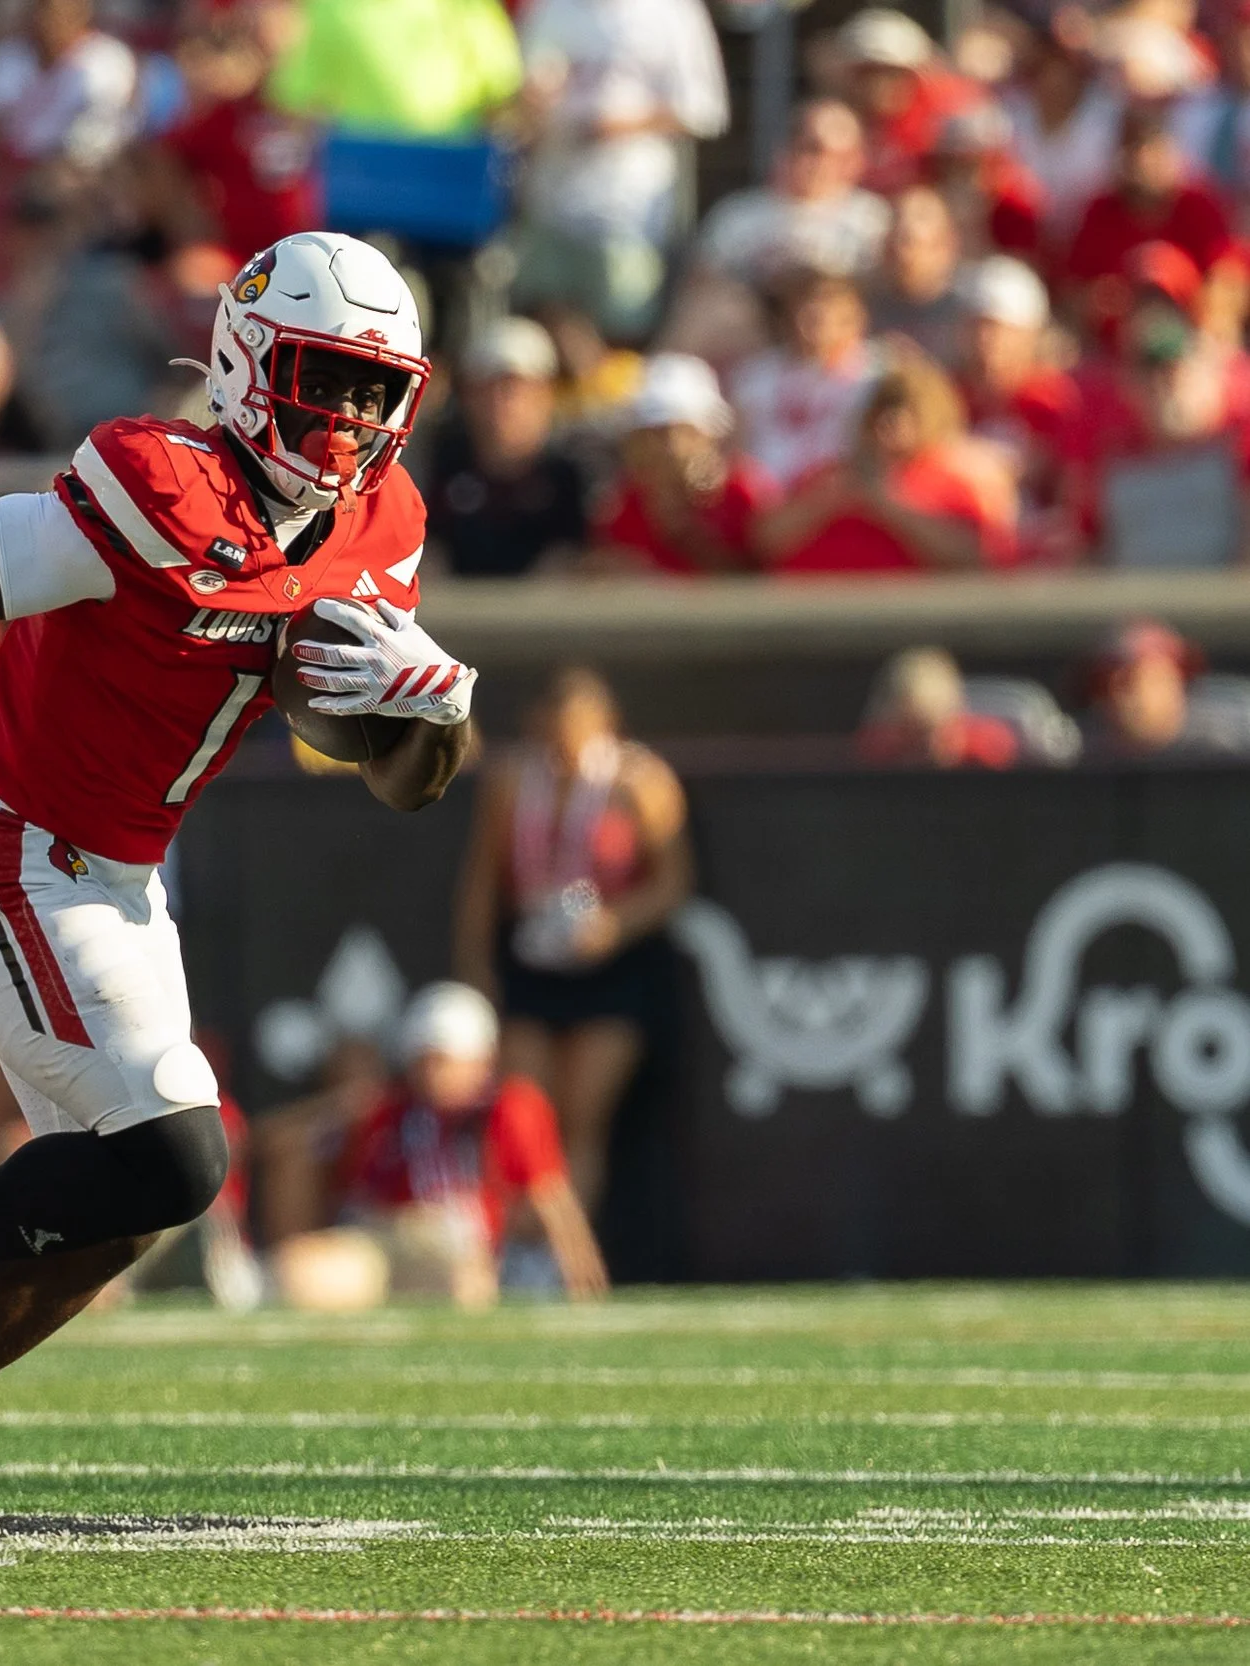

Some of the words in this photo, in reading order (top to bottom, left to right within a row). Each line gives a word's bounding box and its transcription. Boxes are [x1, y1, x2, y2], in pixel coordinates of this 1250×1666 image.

[214, 541, 246, 563] L&N
[162, 672, 266, 804] 1
[945, 862, 1250, 1228] Kro
